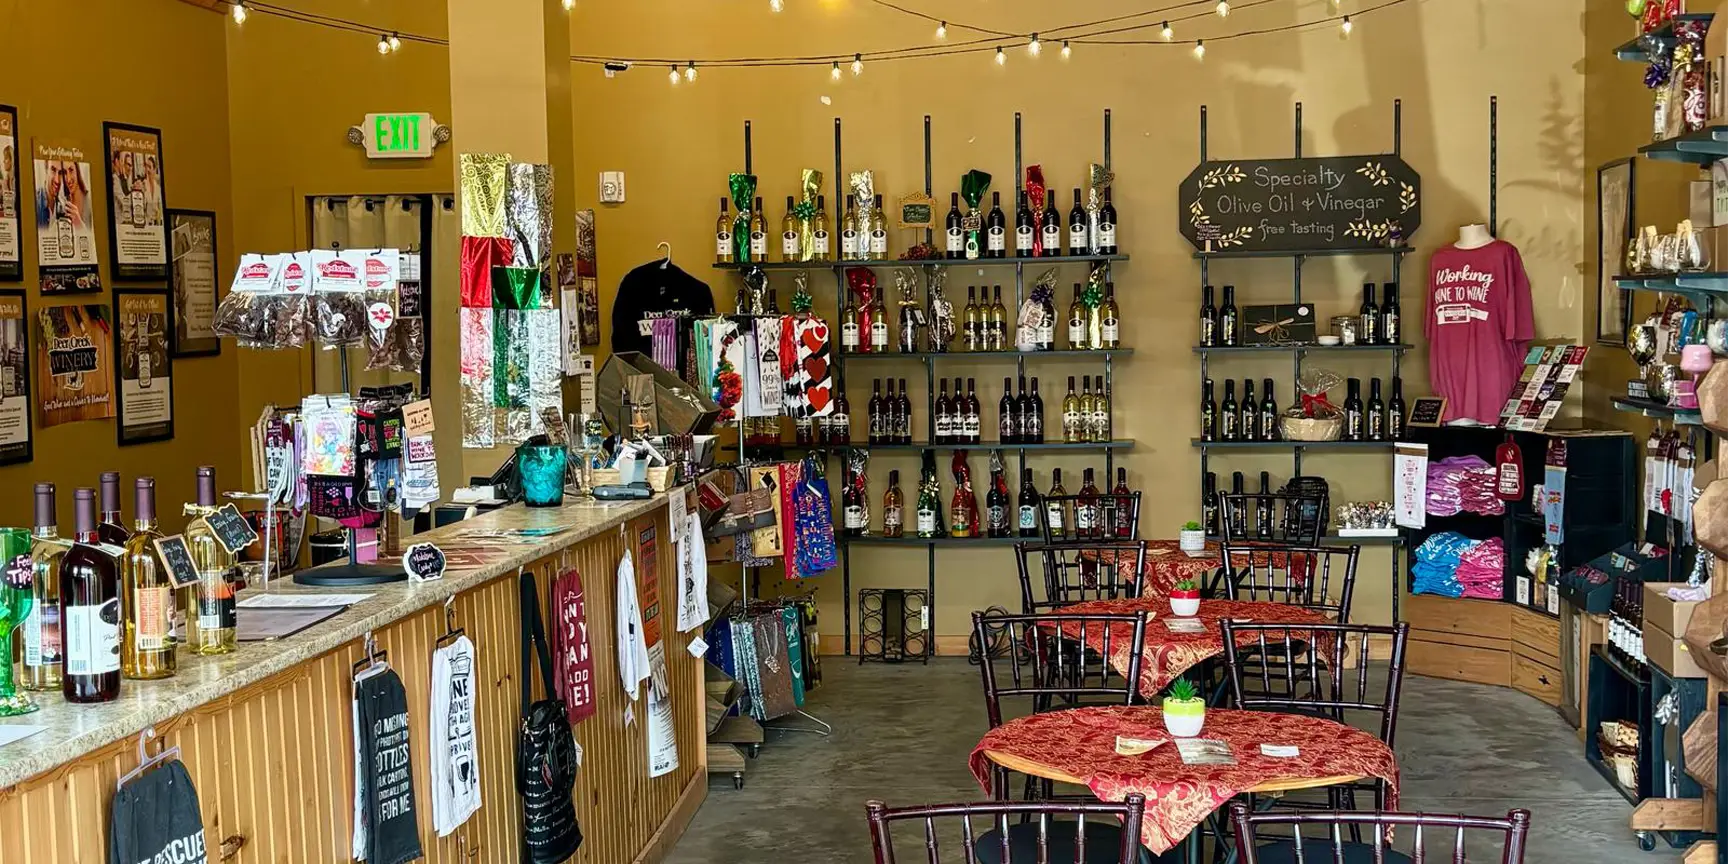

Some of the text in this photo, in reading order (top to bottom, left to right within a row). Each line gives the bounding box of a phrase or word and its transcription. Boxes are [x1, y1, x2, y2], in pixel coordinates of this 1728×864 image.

[375, 115, 422, 151] EXIT
[1254, 165, 1345, 192] Specialty
[1217, 194, 1262, 214] Olive
[1268, 192, 1294, 213] Oil
[1316, 193, 1385, 221] Vinegar
[1257, 218, 1334, 241] free tasting
[1436, 264, 1494, 288] Working
[1454, 286, 1465, 302] TO
[1466, 286, 1489, 303] WINE
[51, 352, 94, 371] WINERY
[376, 743, 409, 773] OTTLES
[381, 799, 398, 821] FOR
